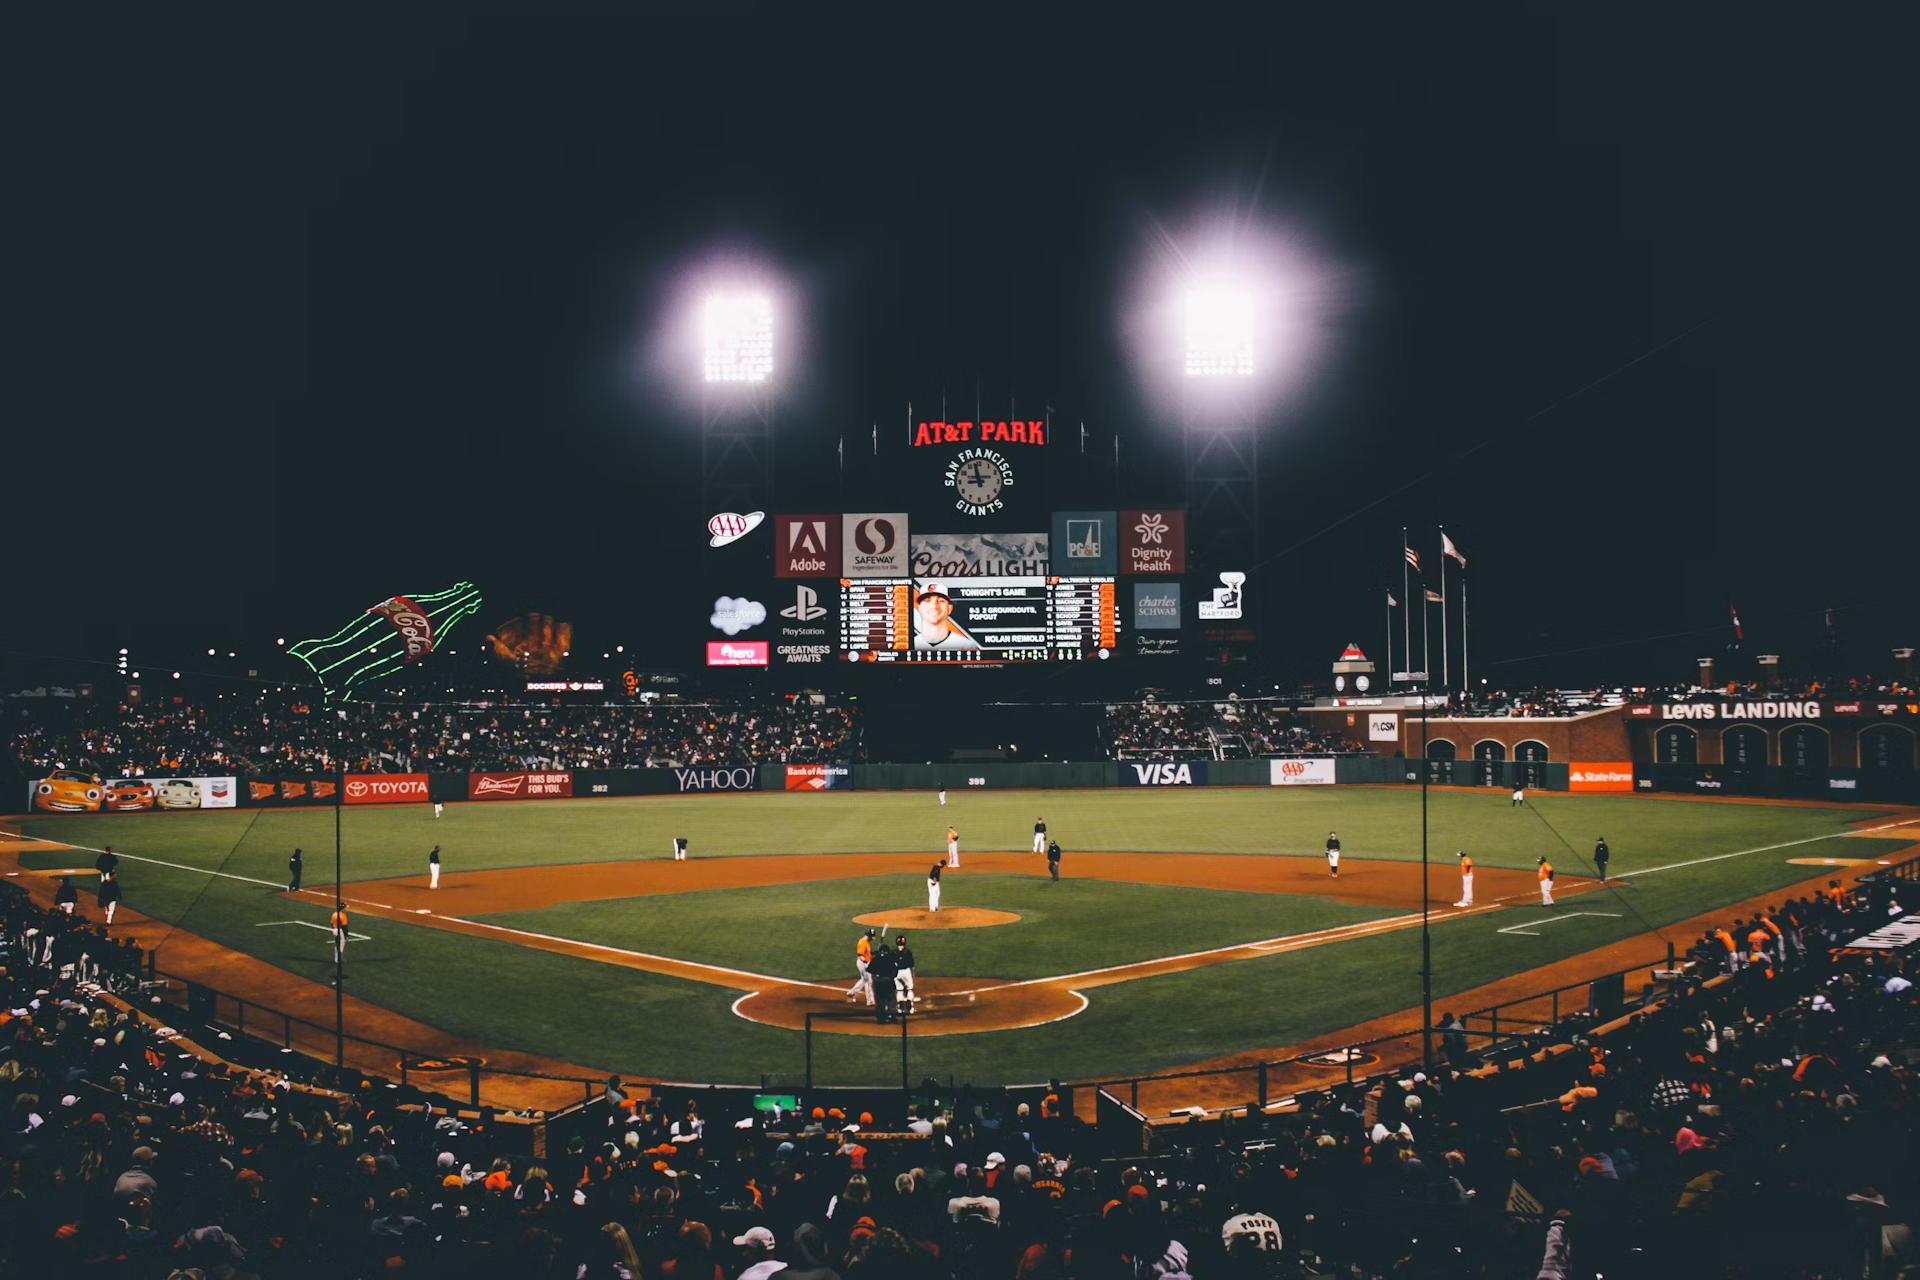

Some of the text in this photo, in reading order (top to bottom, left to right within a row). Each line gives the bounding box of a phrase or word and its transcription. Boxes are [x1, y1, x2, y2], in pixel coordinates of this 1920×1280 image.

[914, 421, 1044, 446] AT&T PARK
[945, 448, 1014, 487] SAN FRANCISCO
[956, 499, 1003, 516] GIANTS
[710, 516, 746, 536] AAA
[1070, 543, 1099, 556] PG&E
[1132, 548, 1172, 560] Dignity
[790, 559, 826, 571] Adobe
[911, 552, 1049, 576] Coors LIGHT
[1134, 561, 1171, 571] Health
[1003, 588, 1026, 596] GAME
[1139, 596, 1176, 606] charles
[393, 611, 432, 656] Cola
[782, 628, 824, 636] PlayStation
[985, 635, 1010, 643] NOLAN
[777, 646, 830, 654] GREATNESS
[1721, 702, 1820, 719] LANDING
[1381, 722, 1395, 732] CSN
[788, 767, 848, 775] Bank of America
[1132, 764, 1192, 784] VISA
[528, 774, 569, 783] THIS BUD'S
[675, 768, 755, 791] YAHOO!
[370, 782, 428, 794] TOYOTA
[528, 785, 561, 793] FOR YOU.
[1240, 1220, 1272, 1230] POSEY
